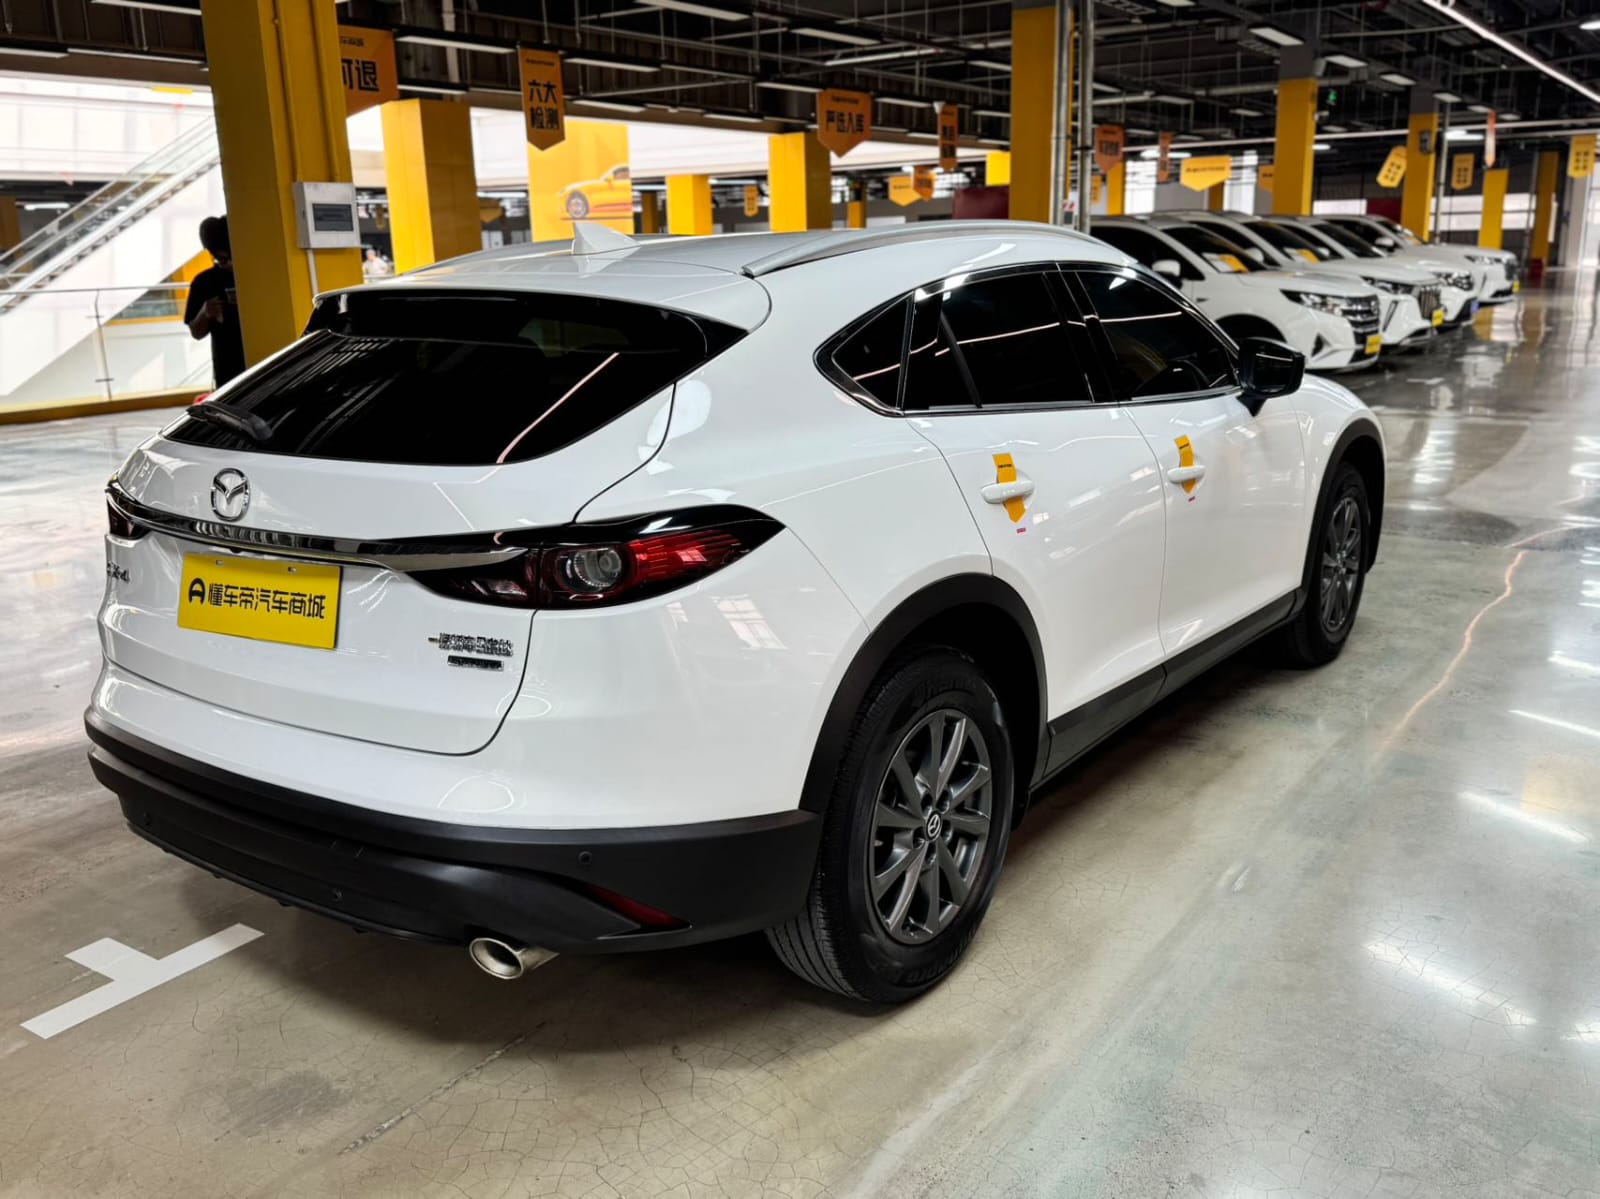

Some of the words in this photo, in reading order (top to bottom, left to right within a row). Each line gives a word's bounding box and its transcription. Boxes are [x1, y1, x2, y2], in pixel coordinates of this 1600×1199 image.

[527, 79, 558, 105] 六大
[208, 582, 326, 619] 懂车帝汽车商城
